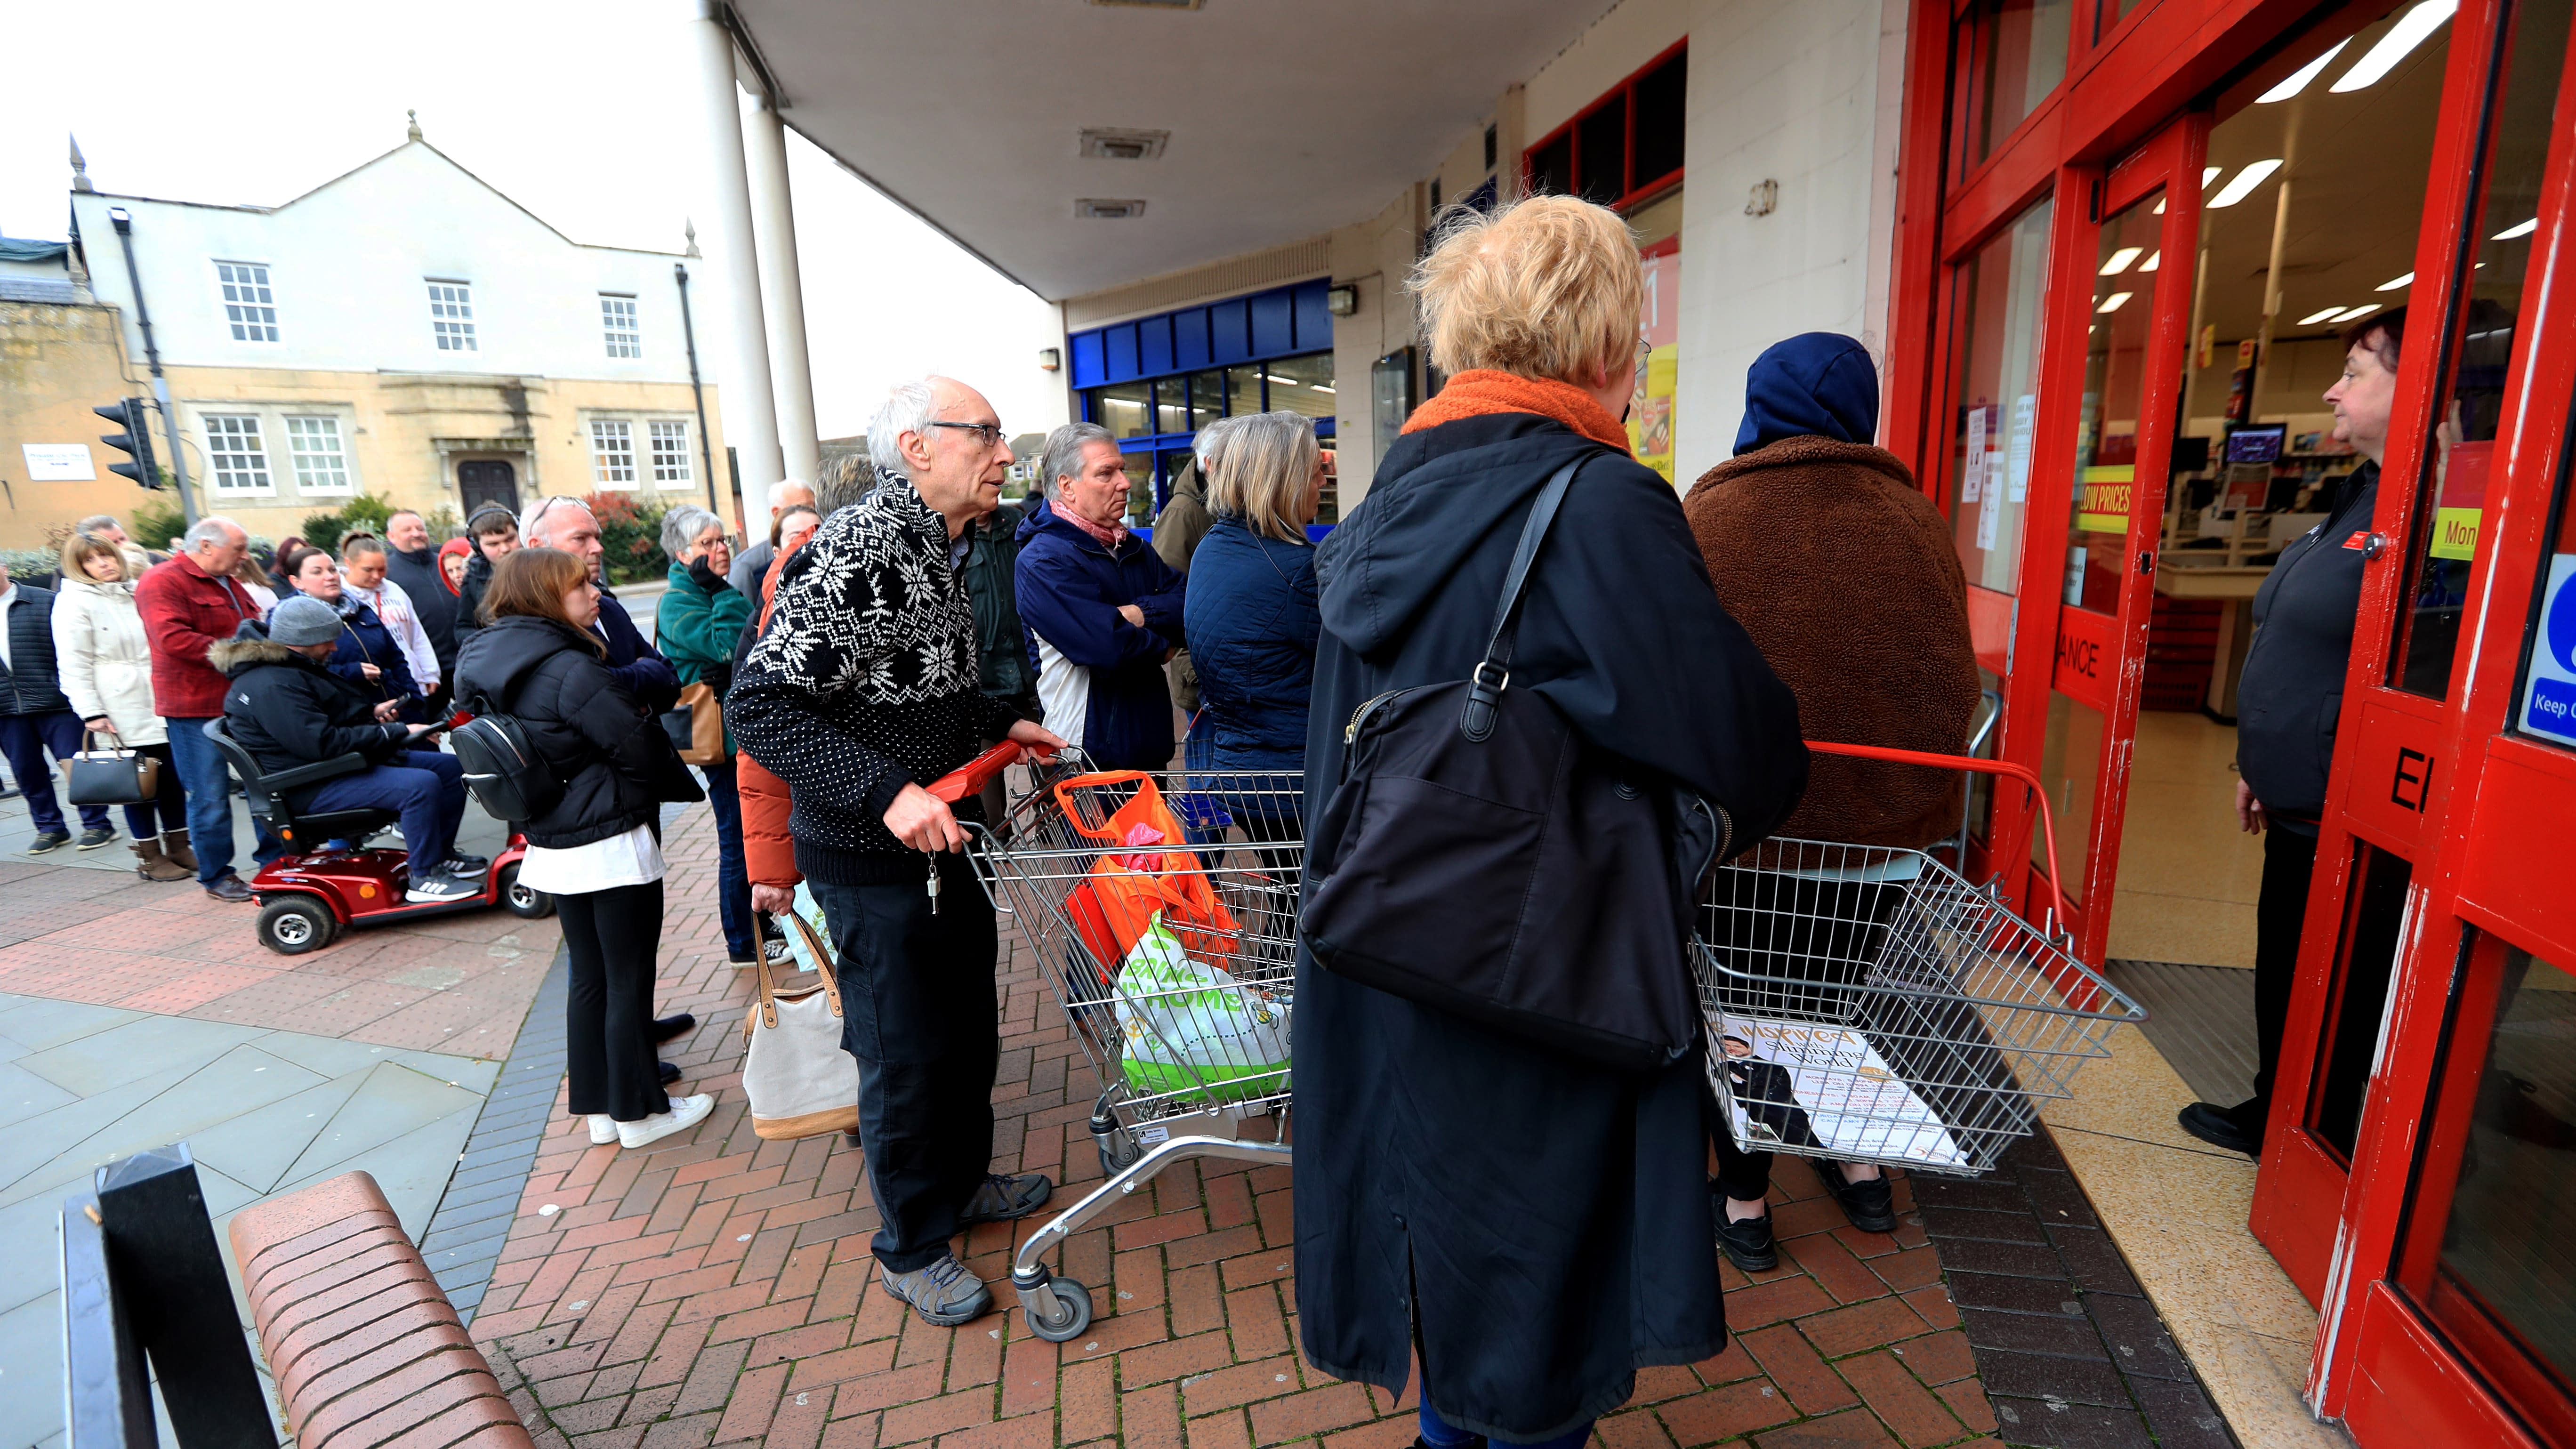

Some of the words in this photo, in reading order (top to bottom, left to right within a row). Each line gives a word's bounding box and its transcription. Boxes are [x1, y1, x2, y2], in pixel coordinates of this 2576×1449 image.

[2081, 485, 2099, 511] LOW
[2098, 485, 2131, 513] PRICES
[2535, 693, 2567, 718] Keep
[1124, 958, 1208, 983] BRING
[1147, 985, 1241, 1012] HOME
[1738, 1024, 1856, 1045] inspired
[1795, 1040, 1824, 1049] with
[1765, 1041, 1867, 1061] Slimming
[1789, 1053, 1854, 1068] World
